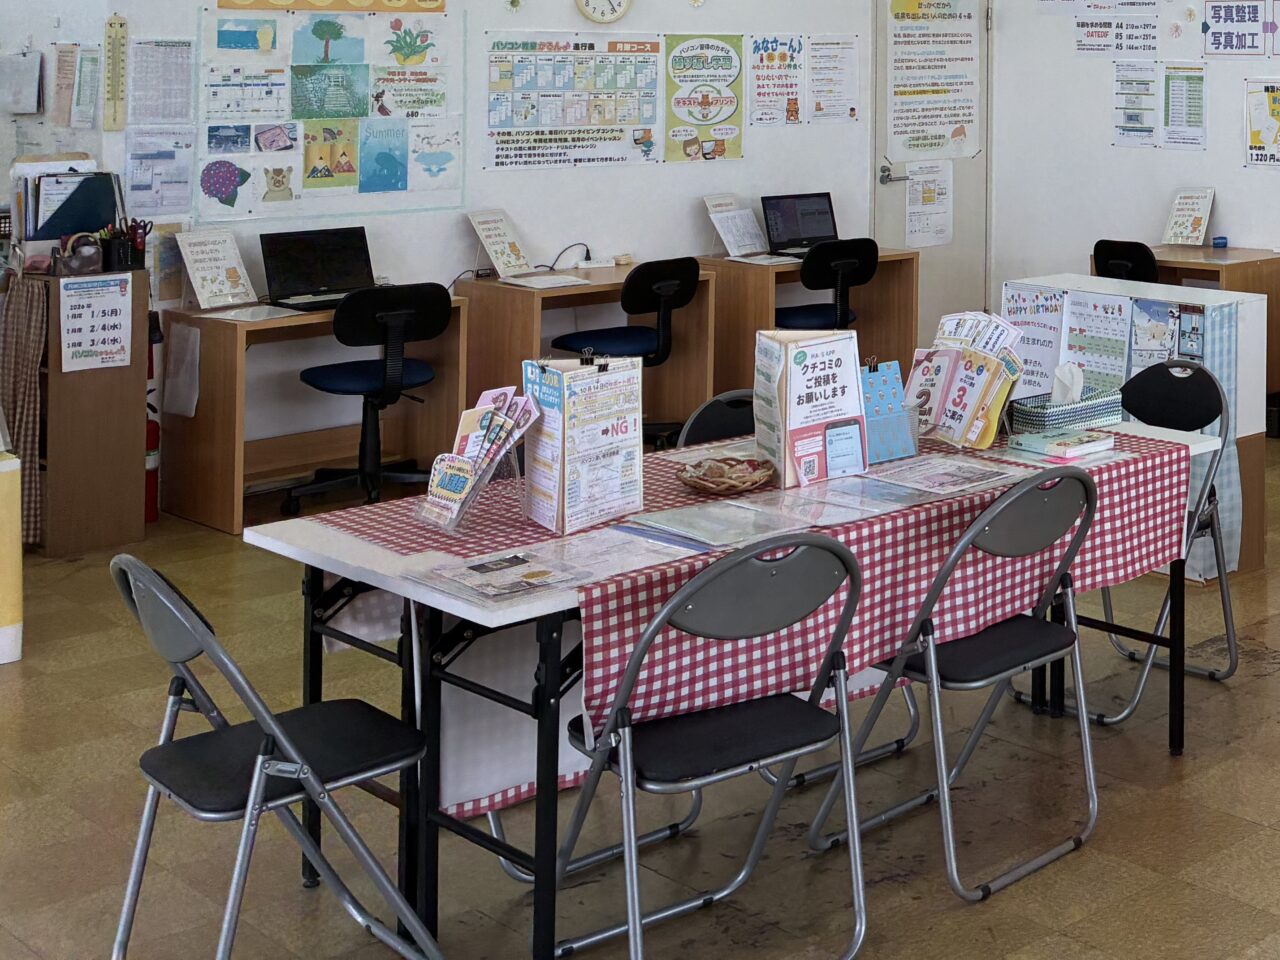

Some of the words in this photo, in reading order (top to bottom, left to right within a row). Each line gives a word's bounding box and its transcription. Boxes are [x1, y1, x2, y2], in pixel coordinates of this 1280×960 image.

[1211, 5, 1259, 23] 写真整理
[1211, 32, 1259, 50] 写真加工
[672, 55, 733, 71] 繰り返し学習
[365, 126, 405, 139] Summer
[1007, 306, 1028, 316] HAPPY
[1029, 303, 1063, 316] BIRTHDAY
[801, 357, 843, 376] クチコミの
[805, 372, 838, 390] ご投稿を
[796, 385, 848, 406] お願いします
